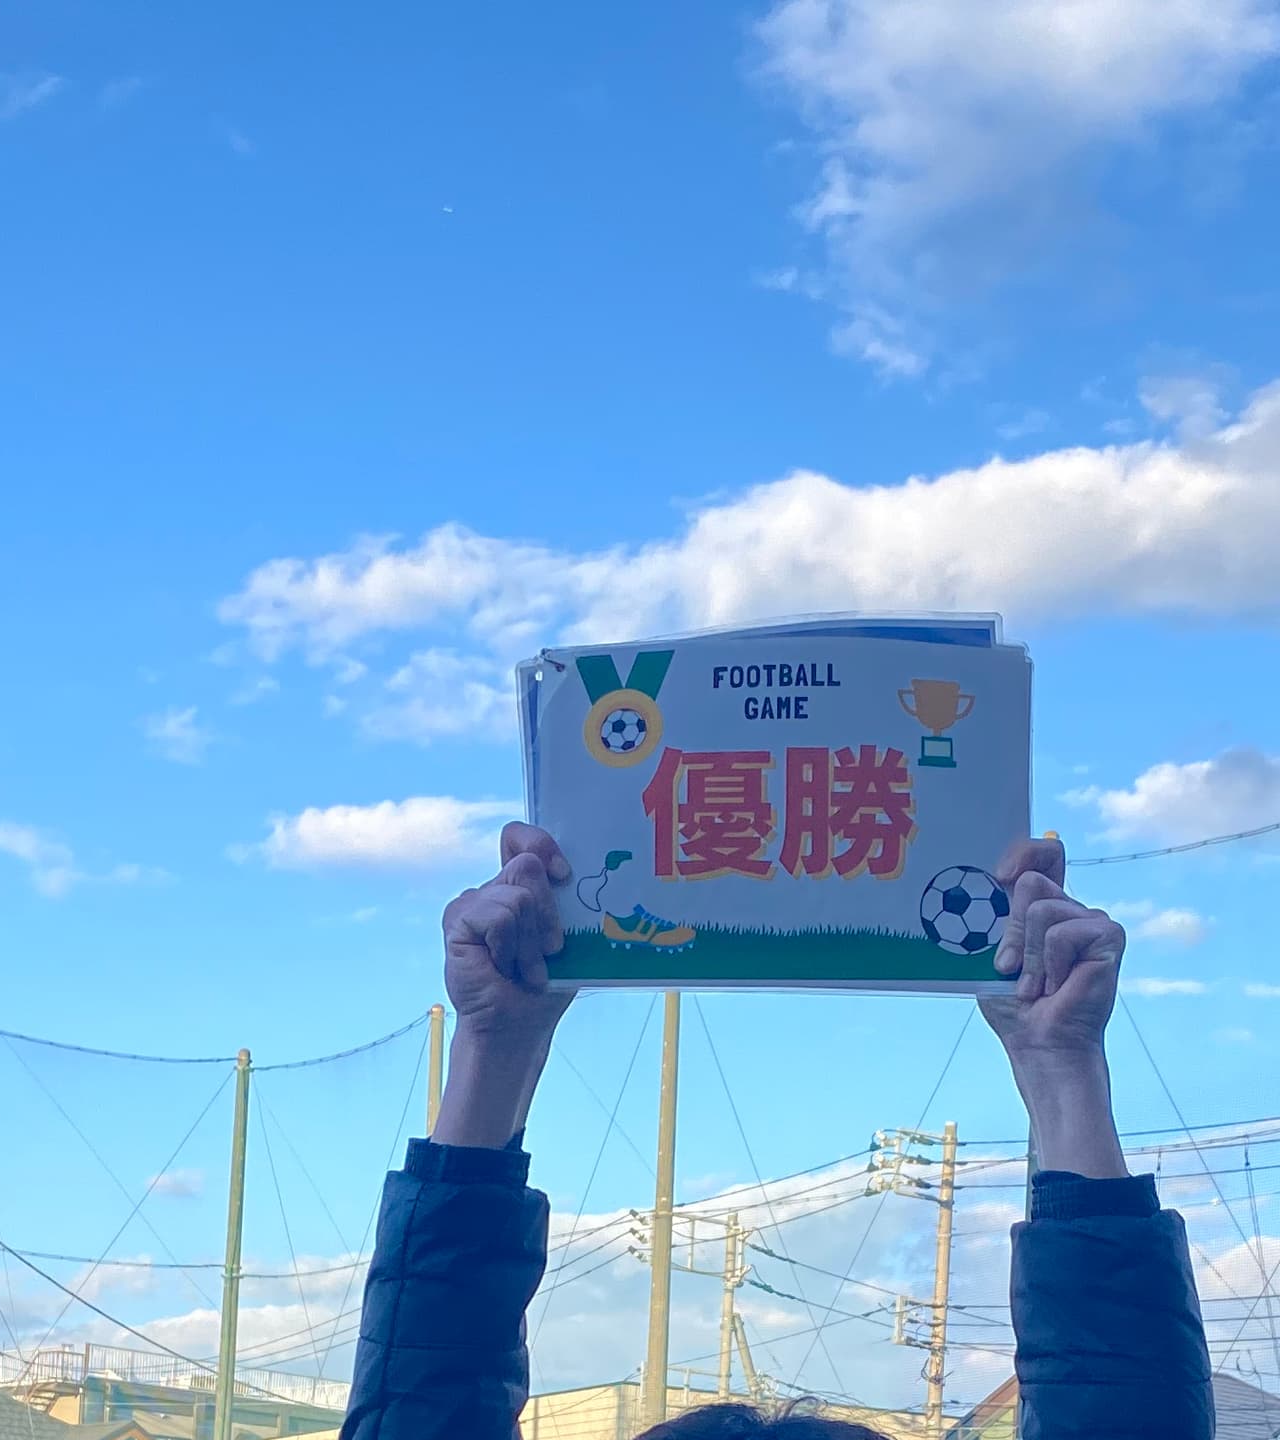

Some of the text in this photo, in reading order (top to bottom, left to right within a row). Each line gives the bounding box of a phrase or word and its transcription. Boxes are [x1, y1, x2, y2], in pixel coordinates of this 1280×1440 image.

[712, 663, 841, 688] FOOTBALL
[744, 696, 809, 720] GAME
[642, 744, 917, 880] 優勝
